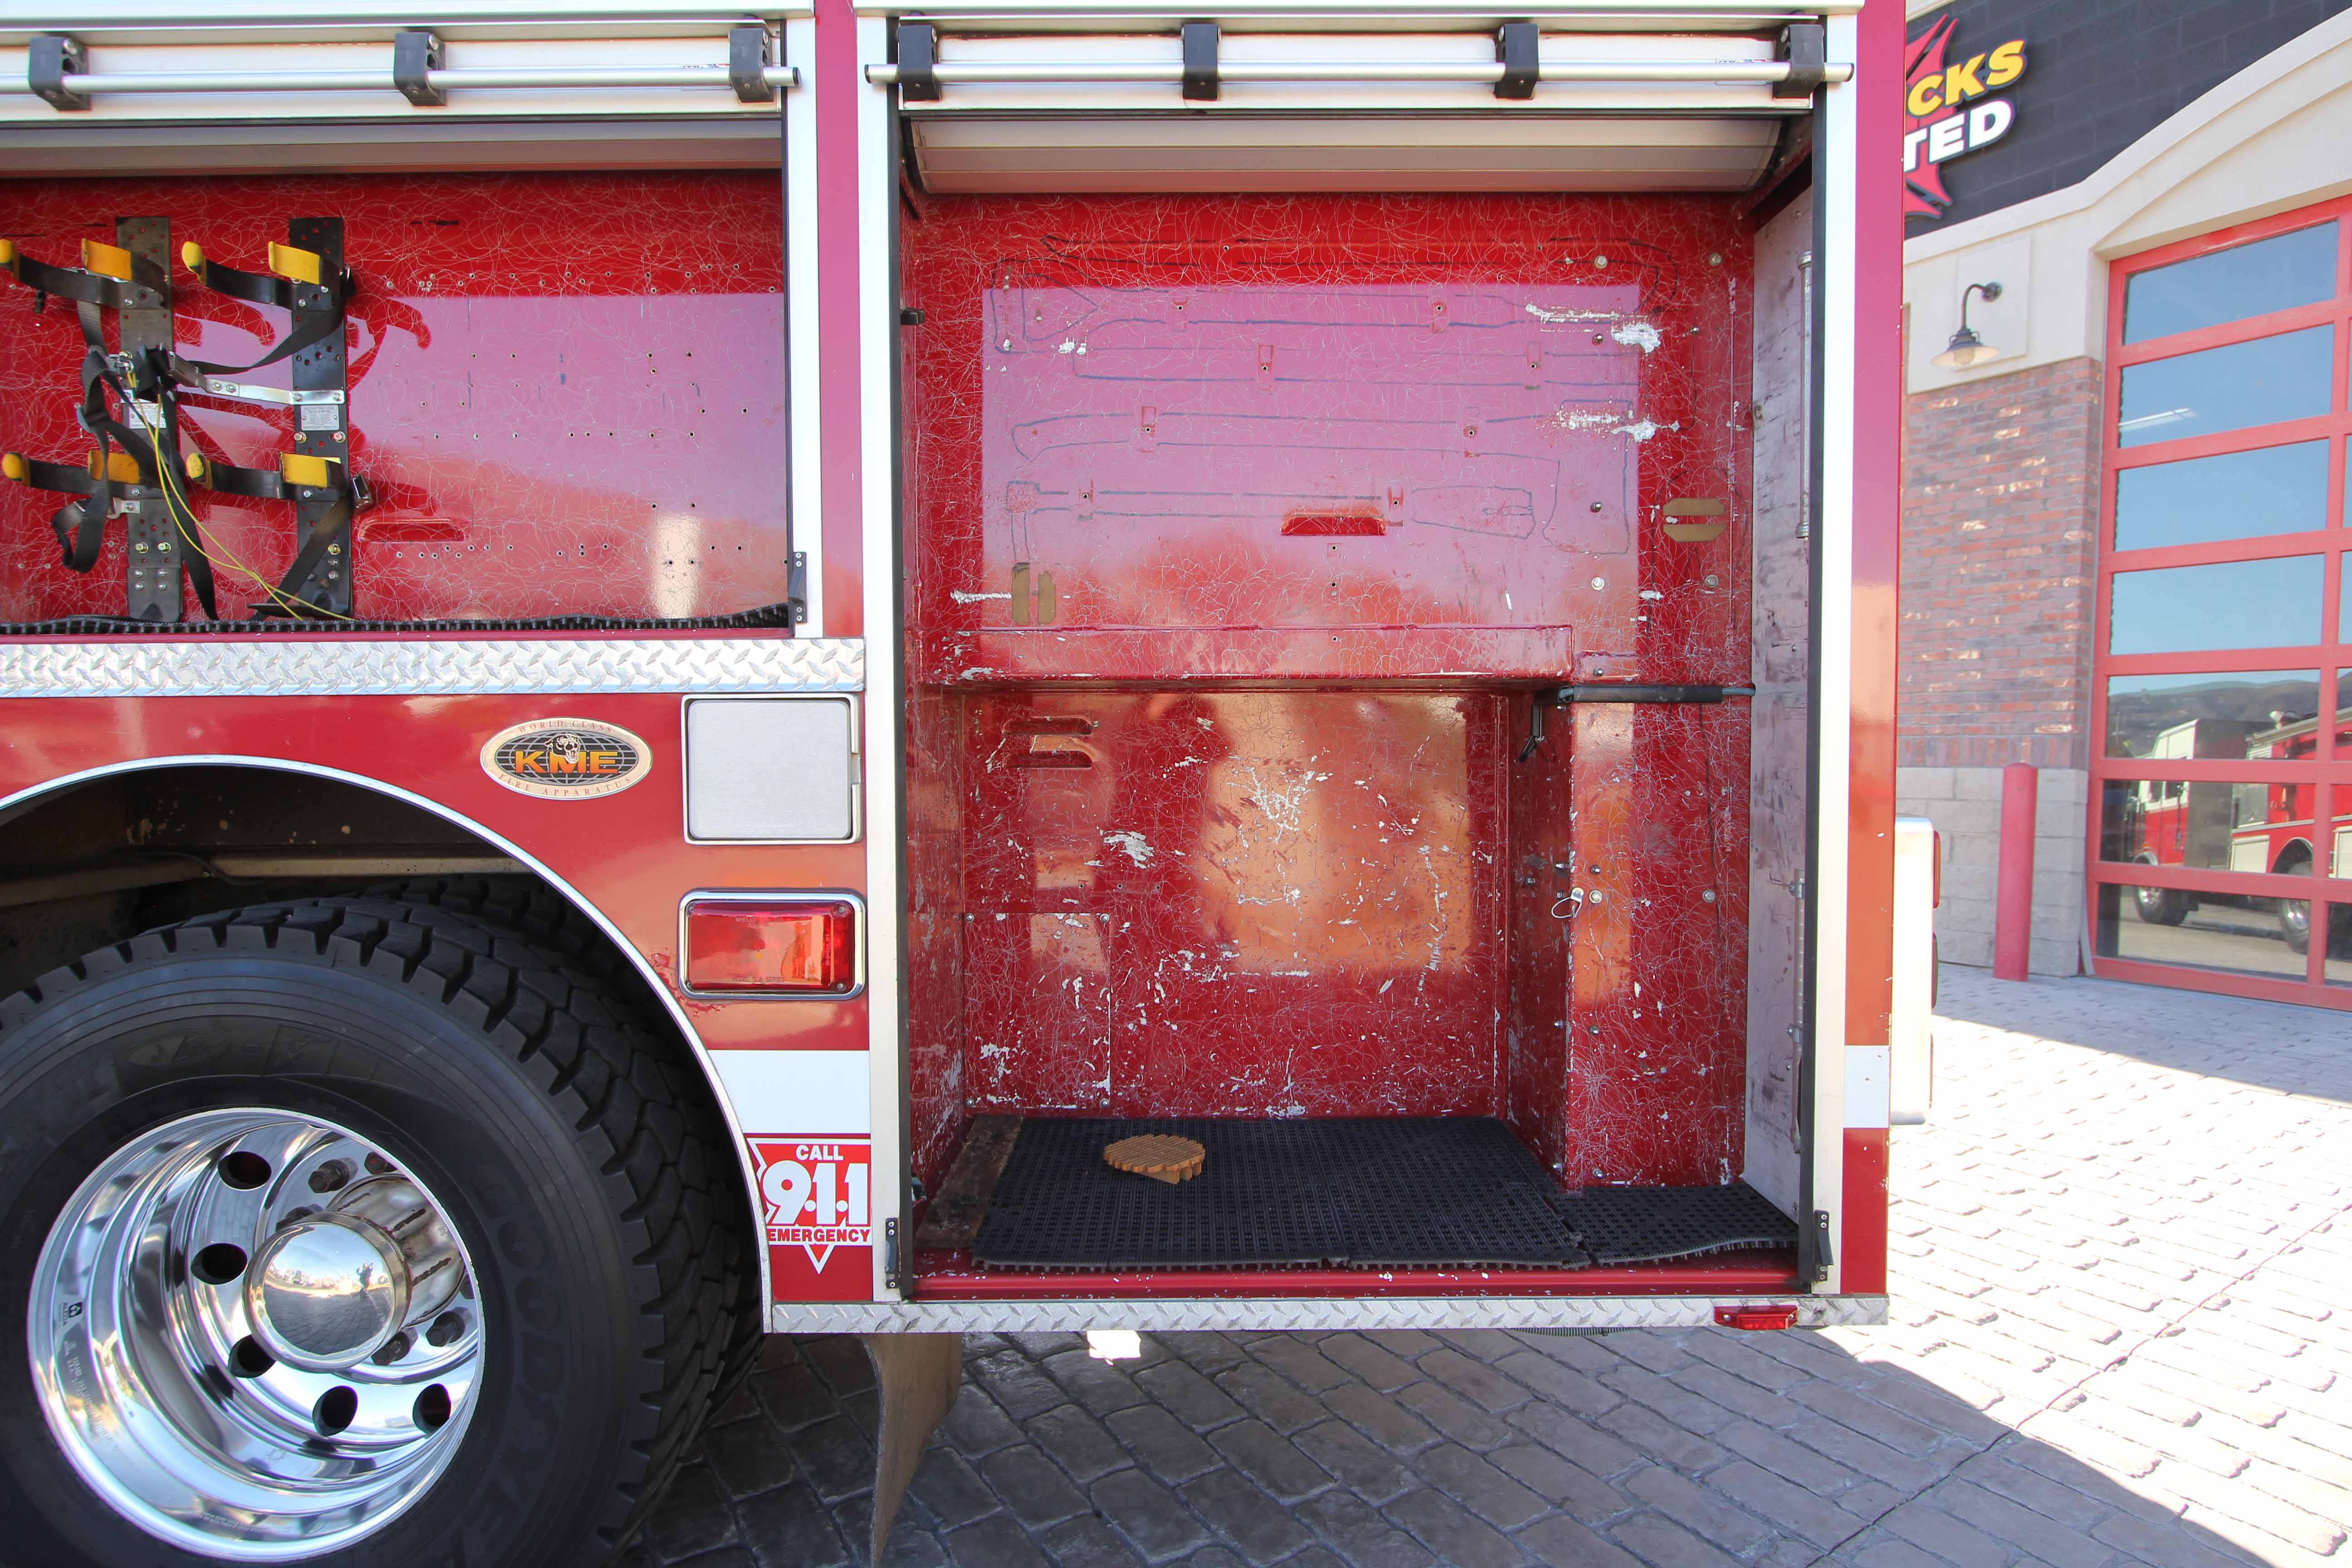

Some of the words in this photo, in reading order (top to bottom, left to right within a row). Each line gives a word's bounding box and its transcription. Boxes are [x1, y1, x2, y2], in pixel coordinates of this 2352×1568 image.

[515, 750, 618, 774] KME
[499, 773, 530, 791] FIRE
[543, 777, 631, 797] APPARATUS
[795, 1144, 844, 1161] CALL
[767, 1229, 871, 1242] EMERGENCY
